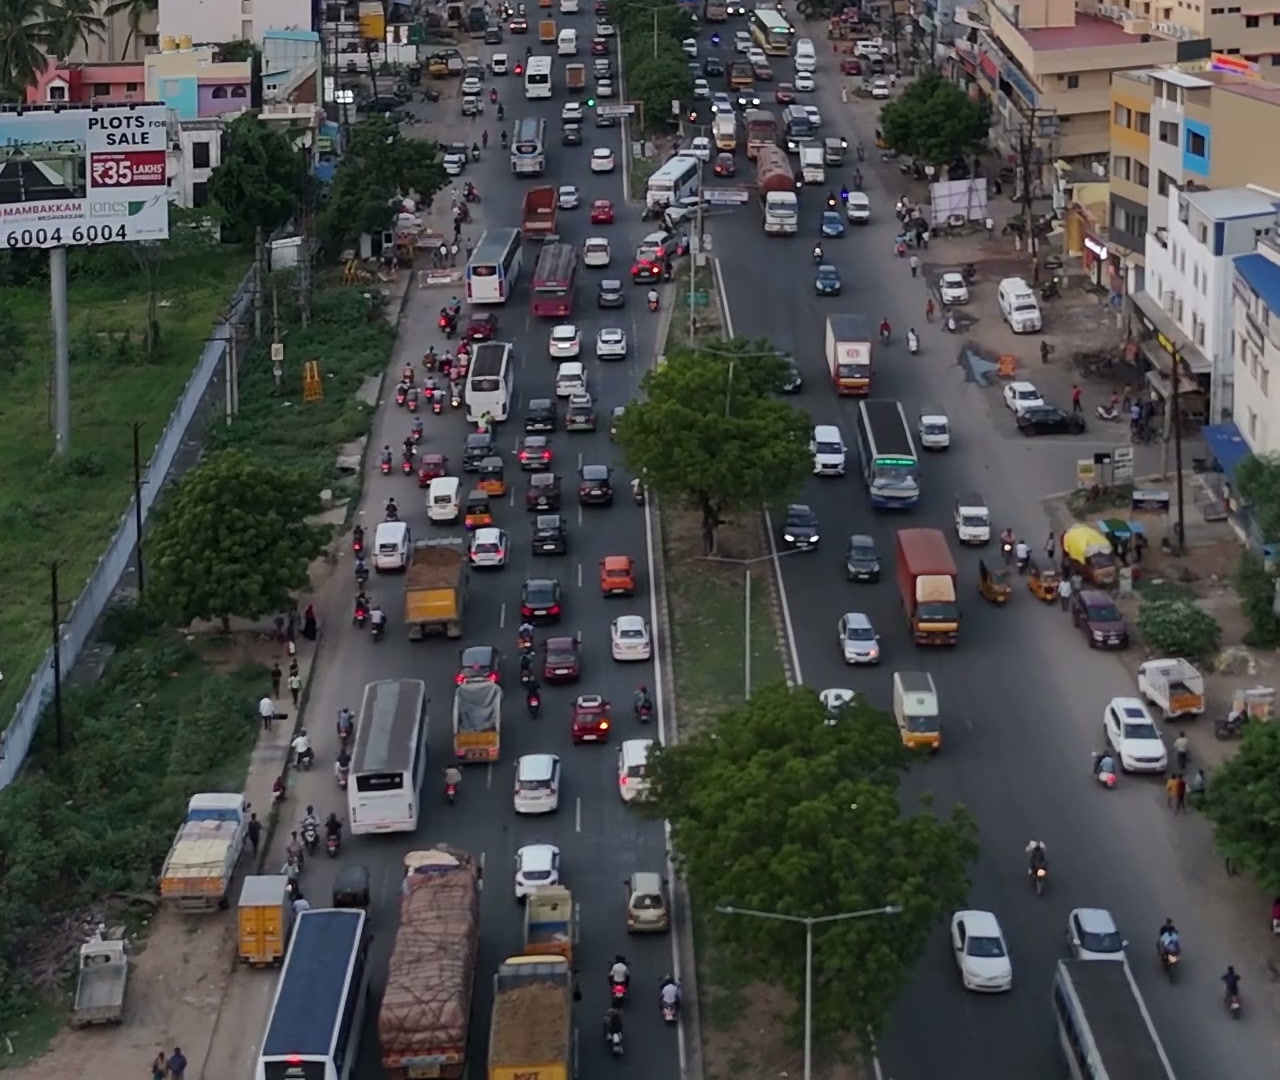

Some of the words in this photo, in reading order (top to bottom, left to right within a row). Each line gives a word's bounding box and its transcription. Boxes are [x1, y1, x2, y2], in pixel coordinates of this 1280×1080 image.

[89, 116, 145, 130] PLOTS
[106, 132, 150, 146] SALE
[93, 161, 132, 185] ₹35
[3, 203, 82, 217] MAMBAKKAM
[6, 227, 62, 247] 6004
[72, 224, 127, 242] 6004
